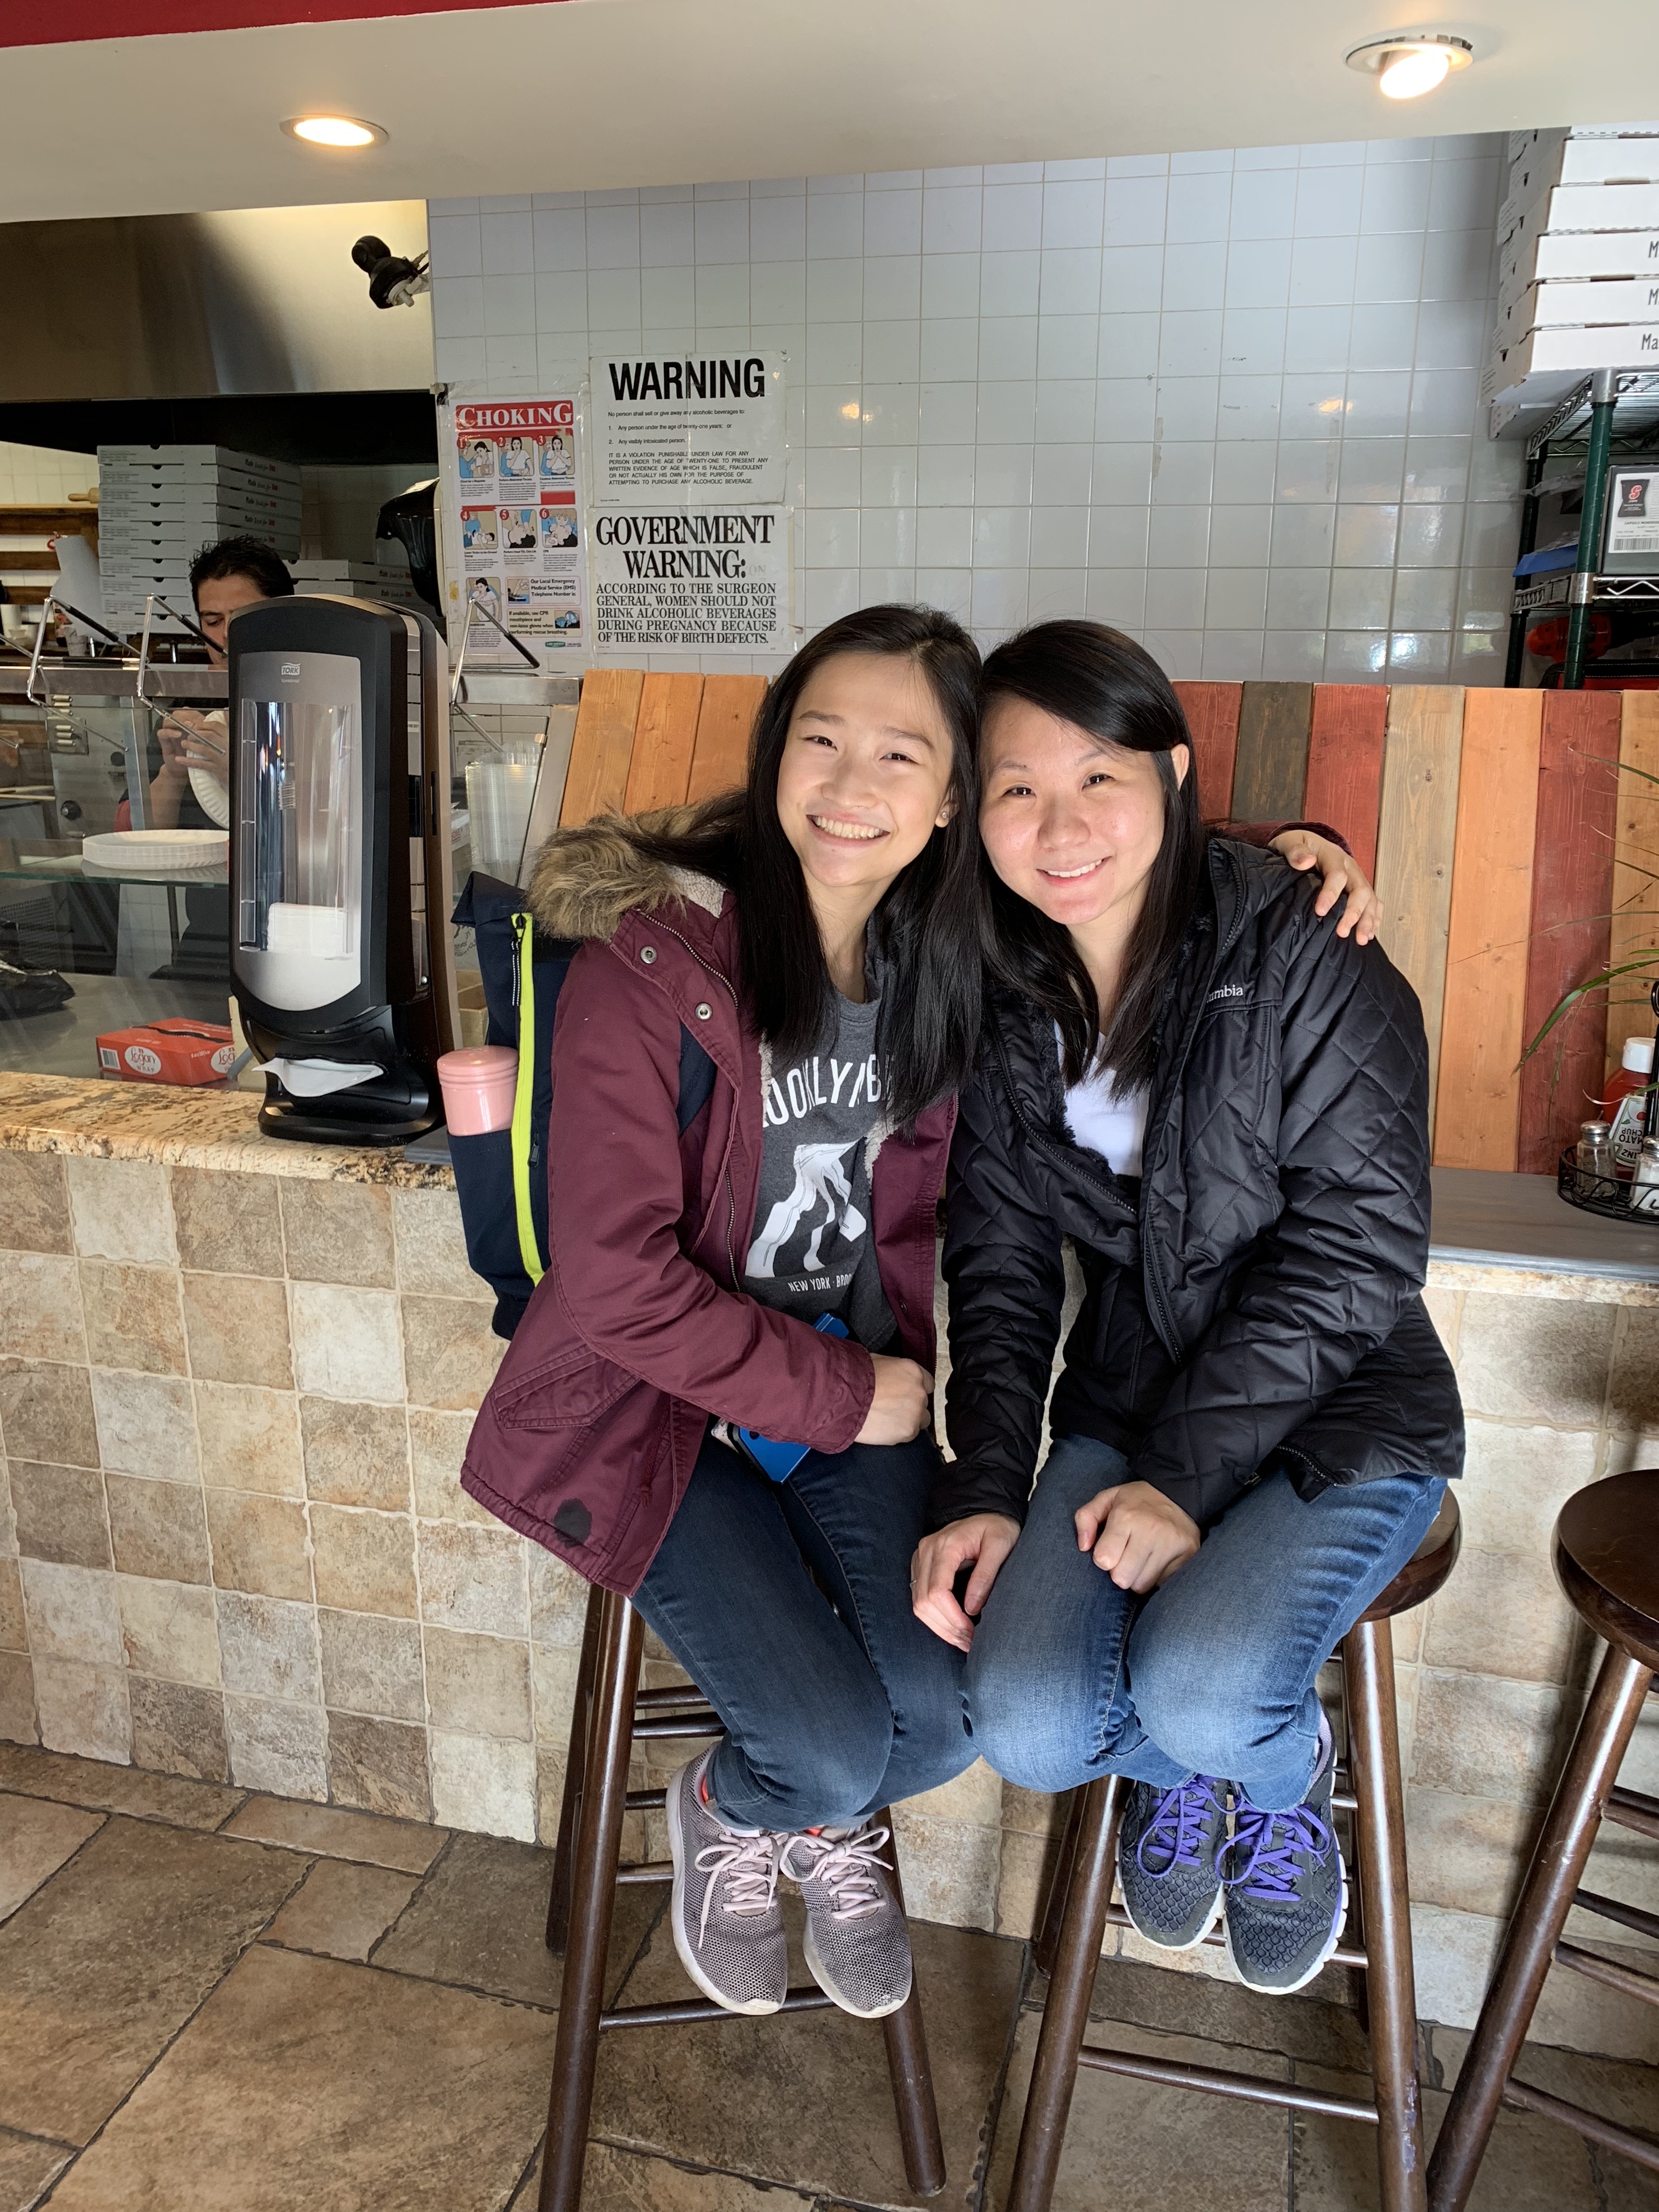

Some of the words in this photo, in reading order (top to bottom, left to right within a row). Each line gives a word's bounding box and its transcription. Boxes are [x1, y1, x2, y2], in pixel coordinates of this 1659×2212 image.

[1649, 241, 1659, 258] M
[1648, 289, 1659, 306] M
[1641, 333, 1659, 350] Ma
[608, 358, 765, 400] WARNING
[459, 403, 572, 427] CHOKING
[499, 437, 504, 446] 2
[538, 436, 544, 445] 3
[462, 510, 467, 520] 4
[501, 510, 507, 519] 5
[542, 509, 547, 518] 6
[596, 515, 775, 545] GOVERNMENT
[623, 549, 746, 578] WARNING:
[596, 583, 667, 594] ACCORDING
[670, 583, 686, 594] TO
[689, 583, 713, 594] THE
[717, 583, 776, 594] SURGEON
[597, 596, 652, 608] GENERAL,
[655, 596, 697, 606] WOMEN
[701, 596, 748, 606] SHOULD
[752, 596, 776, 606] NOT
[597, 608, 634, 618] DRINK
[636, 608, 703, 618] ALCOHOLIC
[707, 608, 776, 619] BEVERAGES
[597, 620, 643, 630] DURING
[647, 620, 717, 631] PREGNANCY
[721, 620, 776, 631] BECAUSE
[598, 632, 613, 642] OF
[613, 632, 636, 642] THE
[637, 632, 663, 642] RISK
[664, 632, 680, 642] OF
[681, 632, 715, 643] BIRTH
[716, 633, 769, 644] DEFECTS.
[1206, 984, 1243, 1003] umbia
[131, 1047, 156, 1066] Logan
[219, 1049, 235, 1065] Log
[1622, 1128, 1643, 1137] CHUP
[1619, 1134, 1643, 1145] MATO
[1621, 1149, 1637, 1159] INZ
[788, 1280, 809, 1292] NEW
[810, 1277, 831, 1290] YORK
